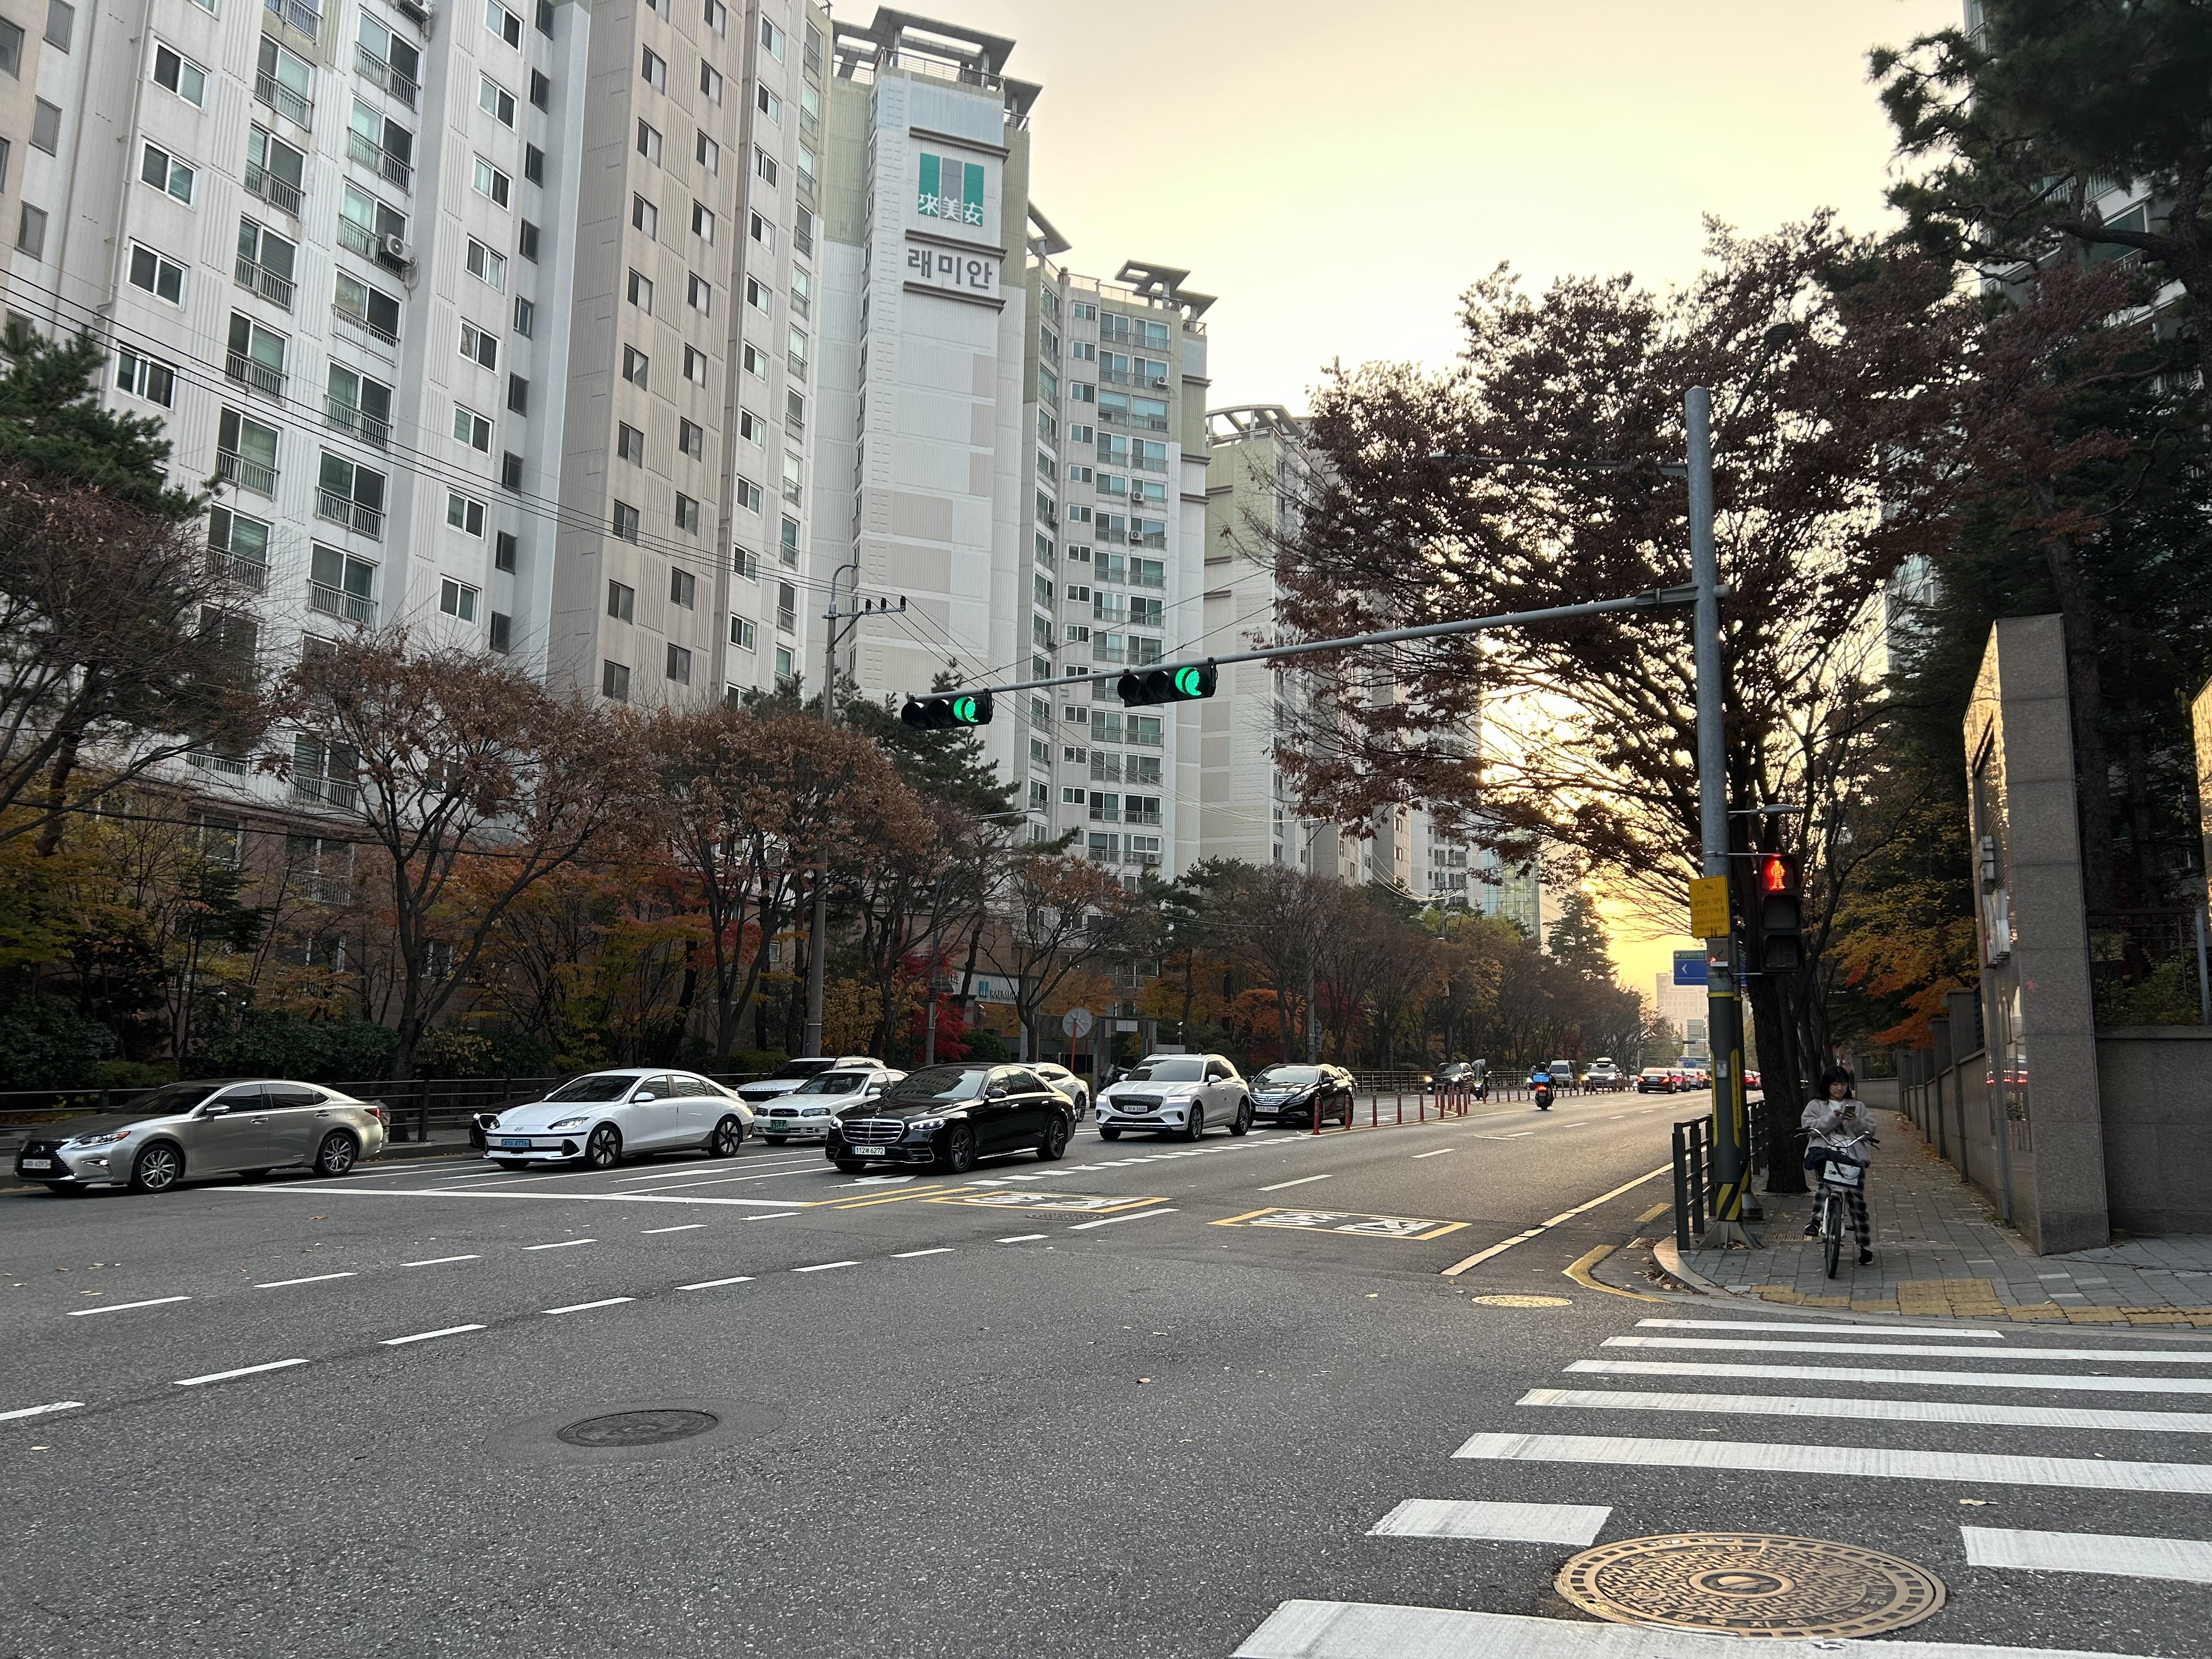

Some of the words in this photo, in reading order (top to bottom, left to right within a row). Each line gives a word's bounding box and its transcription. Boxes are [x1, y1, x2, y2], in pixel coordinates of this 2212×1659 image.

[919, 193, 983, 226] 來美安
[908, 249, 992, 289] 래미안
